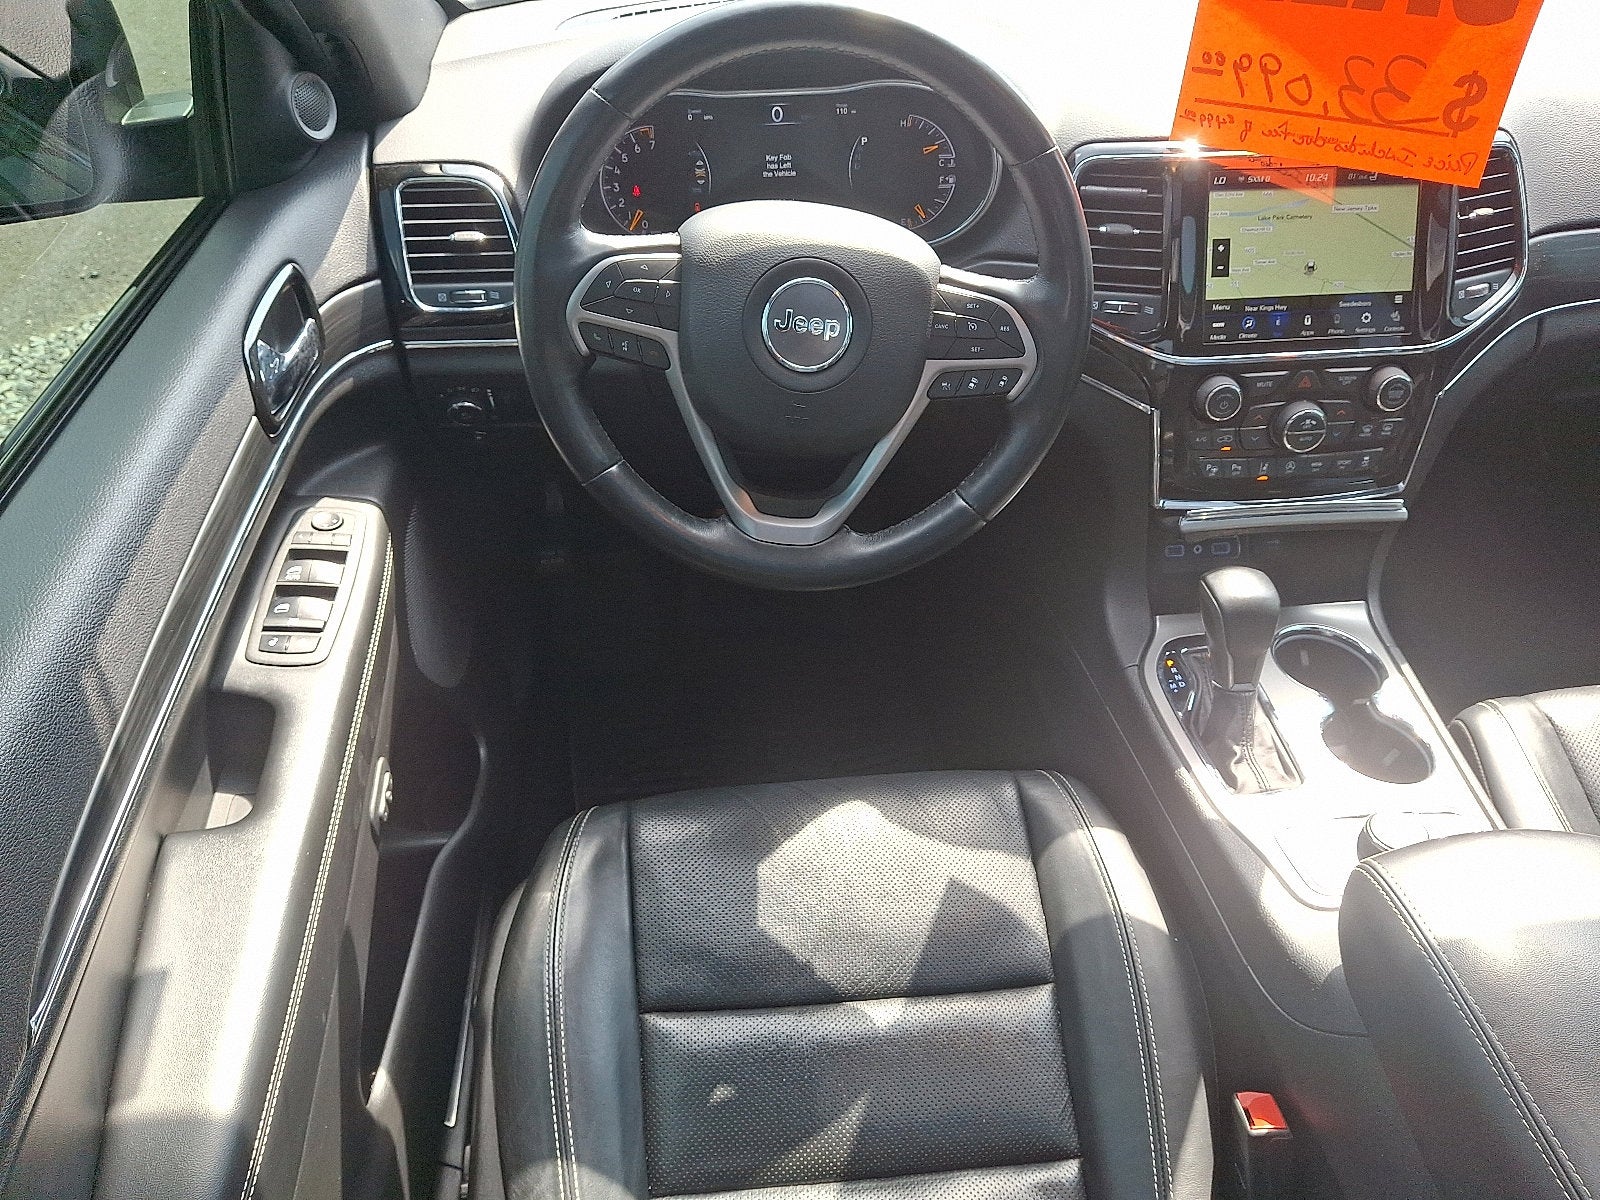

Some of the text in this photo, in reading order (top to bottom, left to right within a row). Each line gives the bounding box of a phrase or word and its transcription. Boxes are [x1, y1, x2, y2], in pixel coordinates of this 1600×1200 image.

[771, 106, 784, 123] 0
[649, 140, 656, 150] 7
[861, 137, 868, 145] P
[634, 144, 641, 154] 6
[621, 153, 628, 163] 5
[765, 154, 778, 162] Key
[938, 159, 945, 167] C
[614, 166, 620, 174] 4
[1213, 176, 1227, 185] LO
[613, 183, 620, 192] 3
[618, 198, 625, 208] 2
[642, 220, 649, 229] 0
[773, 308, 841, 341] Jeep
